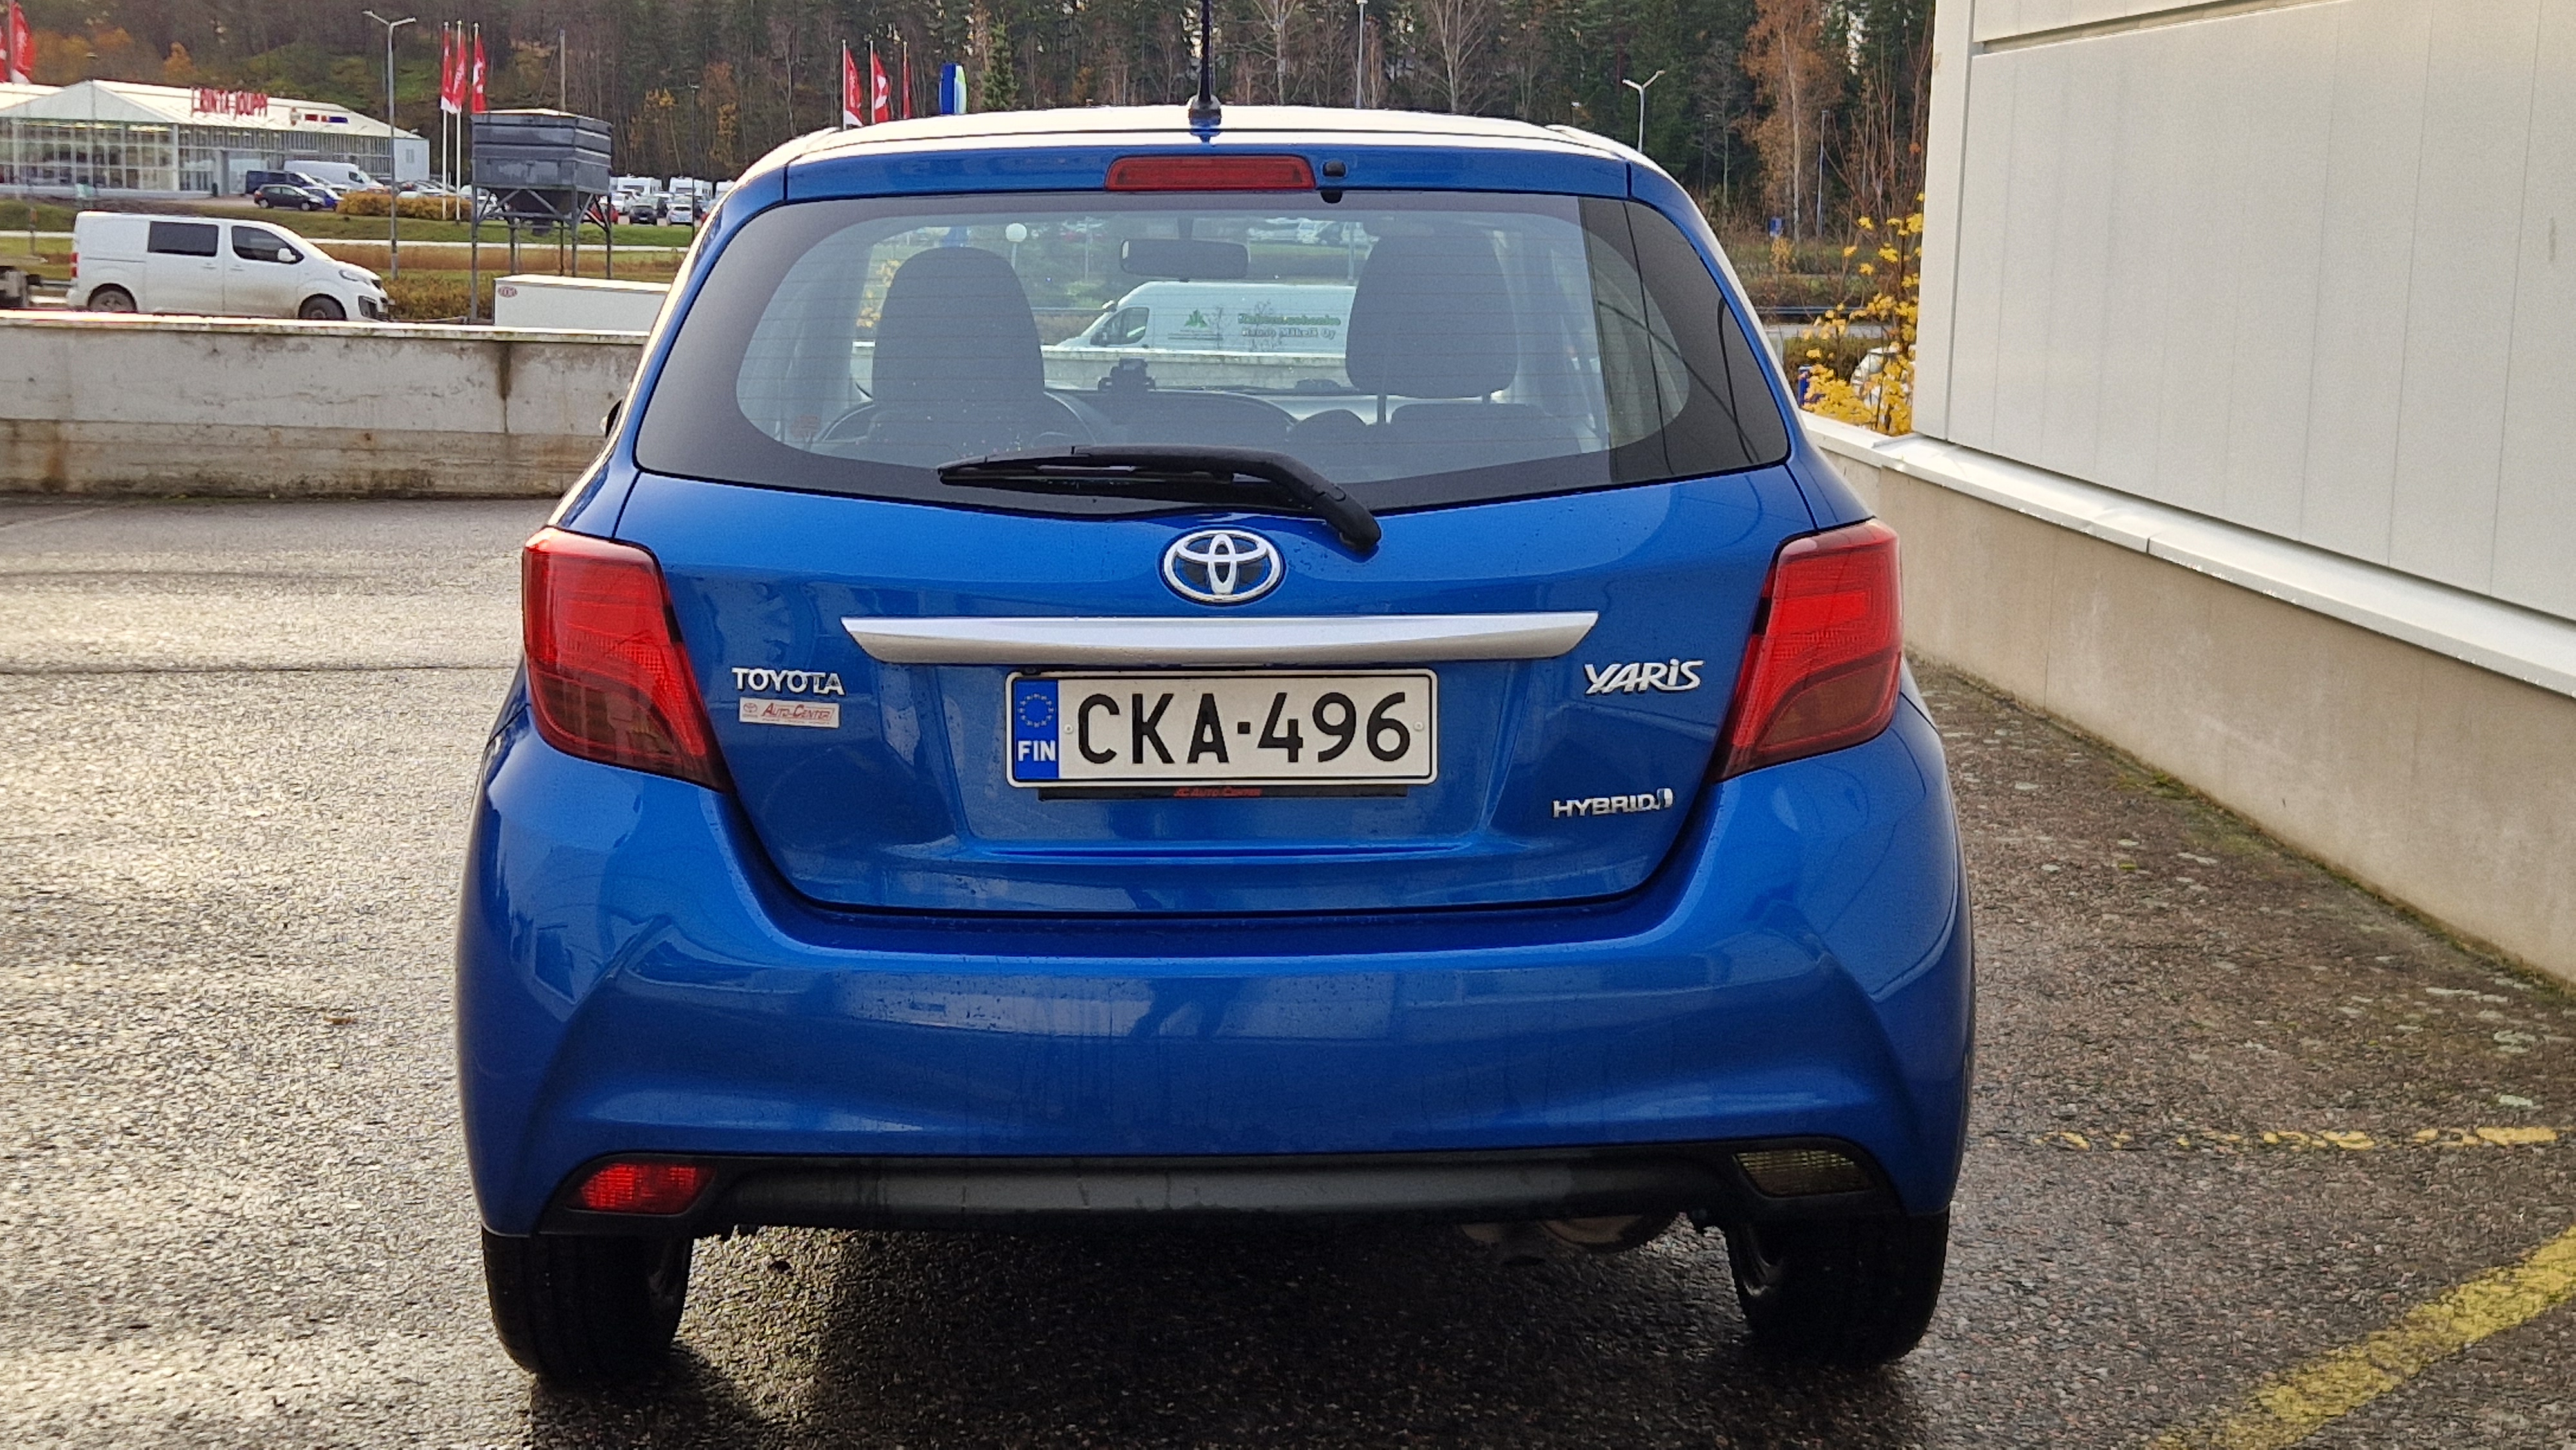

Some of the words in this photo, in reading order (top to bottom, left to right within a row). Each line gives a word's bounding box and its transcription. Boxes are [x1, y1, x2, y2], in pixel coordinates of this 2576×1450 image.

[732, 668, 845, 695] TOYOTA
[1018, 740, 1056, 762] FIN
[1553, 793, 1658, 818] HYBRID
